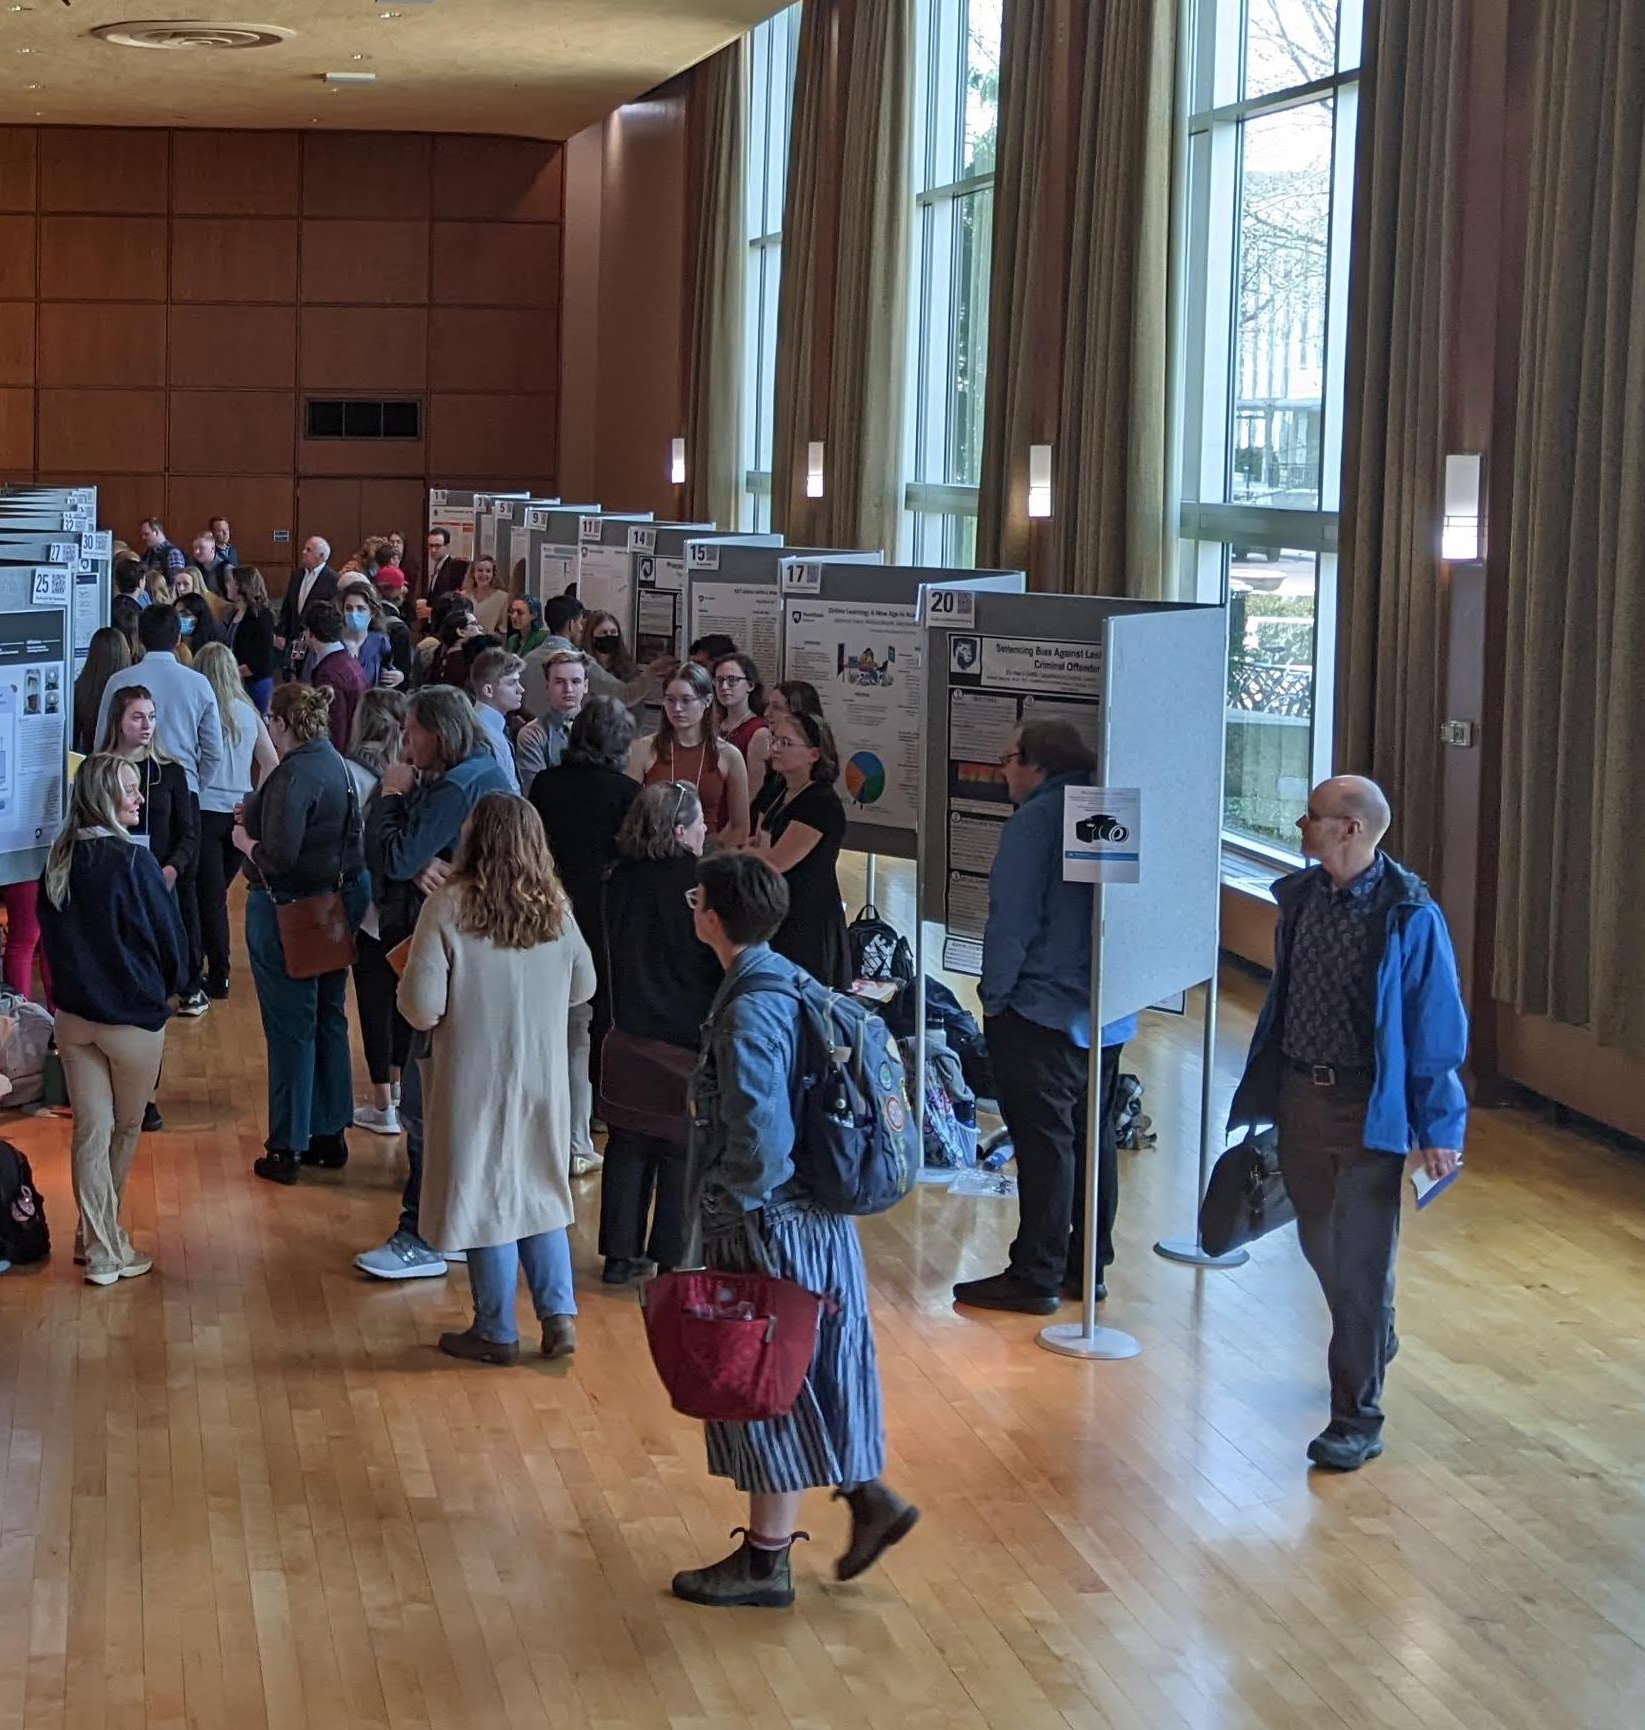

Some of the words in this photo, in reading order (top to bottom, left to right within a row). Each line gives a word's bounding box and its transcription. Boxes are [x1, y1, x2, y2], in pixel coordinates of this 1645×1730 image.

[499, 503, 505, 513] 5
[532, 512, 539, 523] 9
[582, 519, 592, 532] 11
[83, 534, 94, 550] 30
[633, 531, 646, 545] 14
[51, 545, 60, 560] 27
[689, 545, 706, 561] 15
[787, 565, 804, 582] 17
[36, 574, 49, 593] 25
[931, 592, 954, 613] 20
[996, 643, 1034, 657] Sentencing
[1035, 646, 1052, 656] Bias
[1054, 649, 1084, 660] Against
[1035, 660, 1065, 670] Criminal
